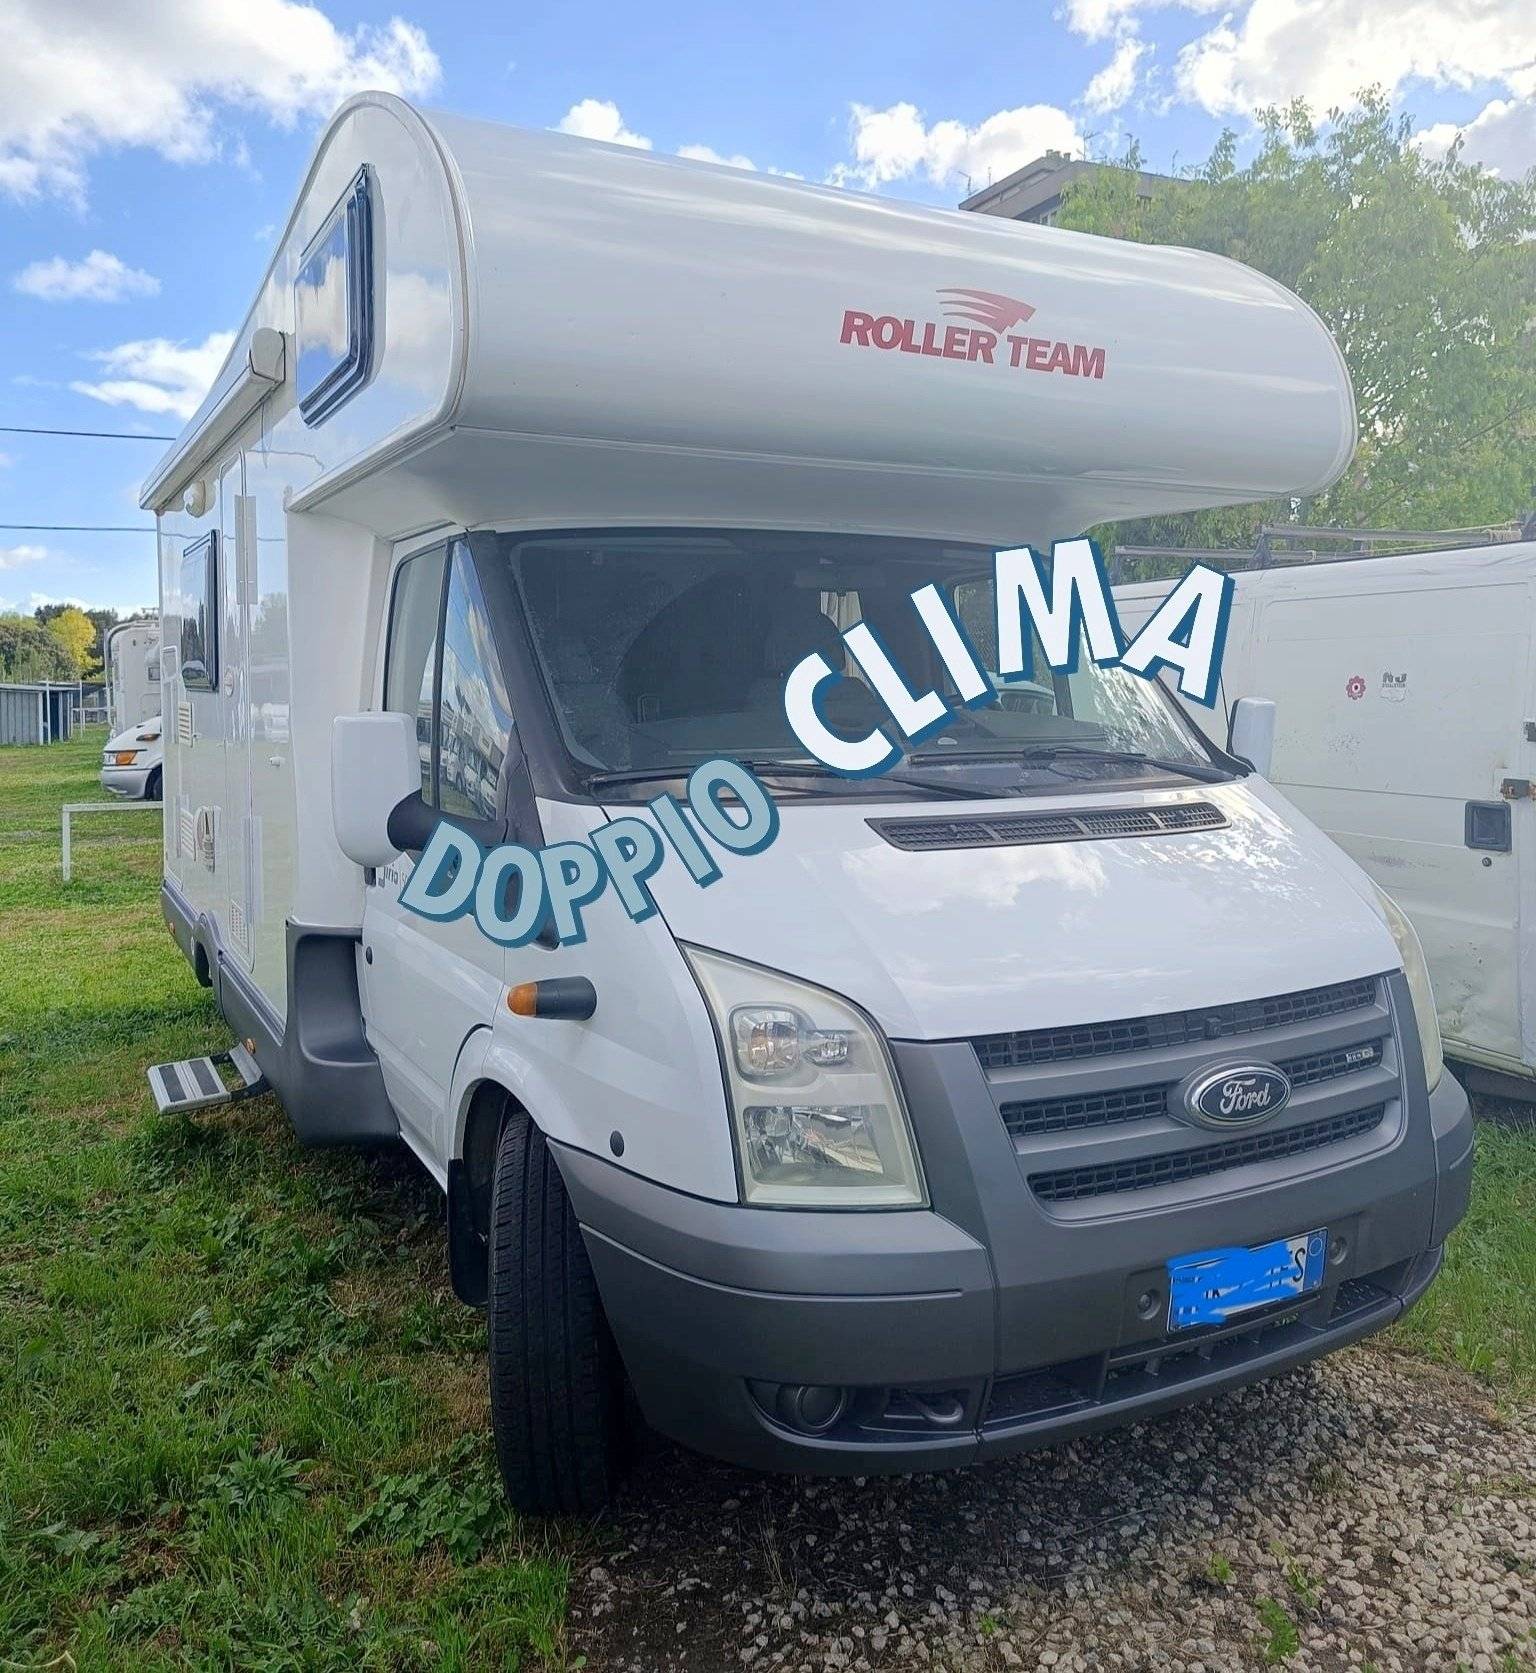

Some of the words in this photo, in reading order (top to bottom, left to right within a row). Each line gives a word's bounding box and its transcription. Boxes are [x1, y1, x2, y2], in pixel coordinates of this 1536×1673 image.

[839, 309, 998, 365] ROLLER
[1006, 334, 1106, 380] TEAM
[1219, 1077, 1272, 1115] Ford
